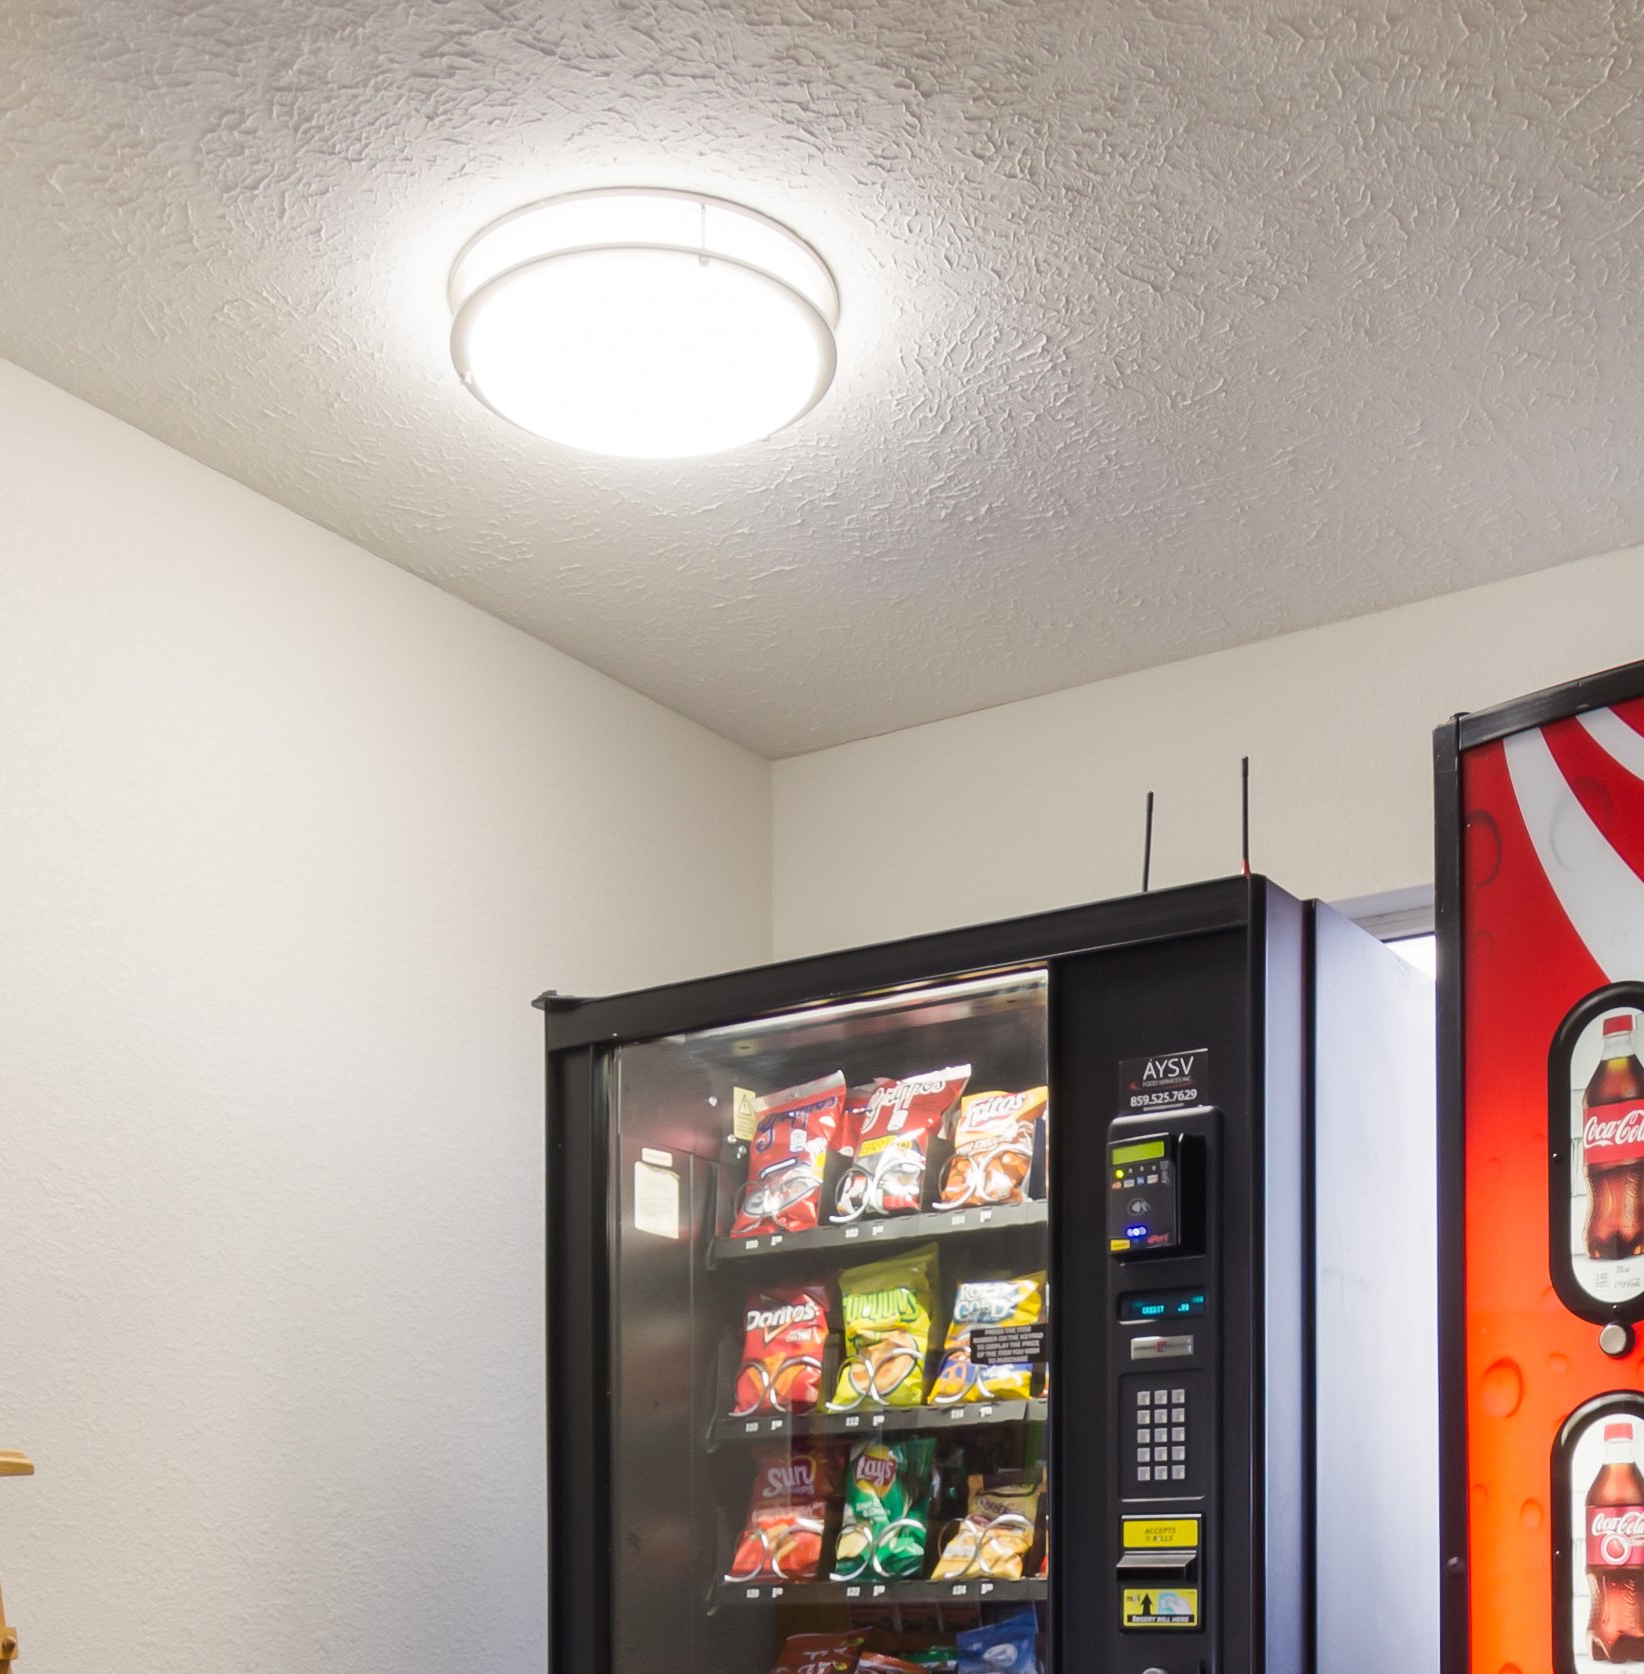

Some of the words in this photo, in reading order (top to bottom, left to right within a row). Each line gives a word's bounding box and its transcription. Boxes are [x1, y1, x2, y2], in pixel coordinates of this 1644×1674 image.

[1130, 1089, 1197, 1107] 859.525.7629
[746, 1300, 817, 1331] Doritos
[1142, 1305, 1164, 1314] CREDIT
[1145, 1527, 1176, 1535] ACCEPTS
